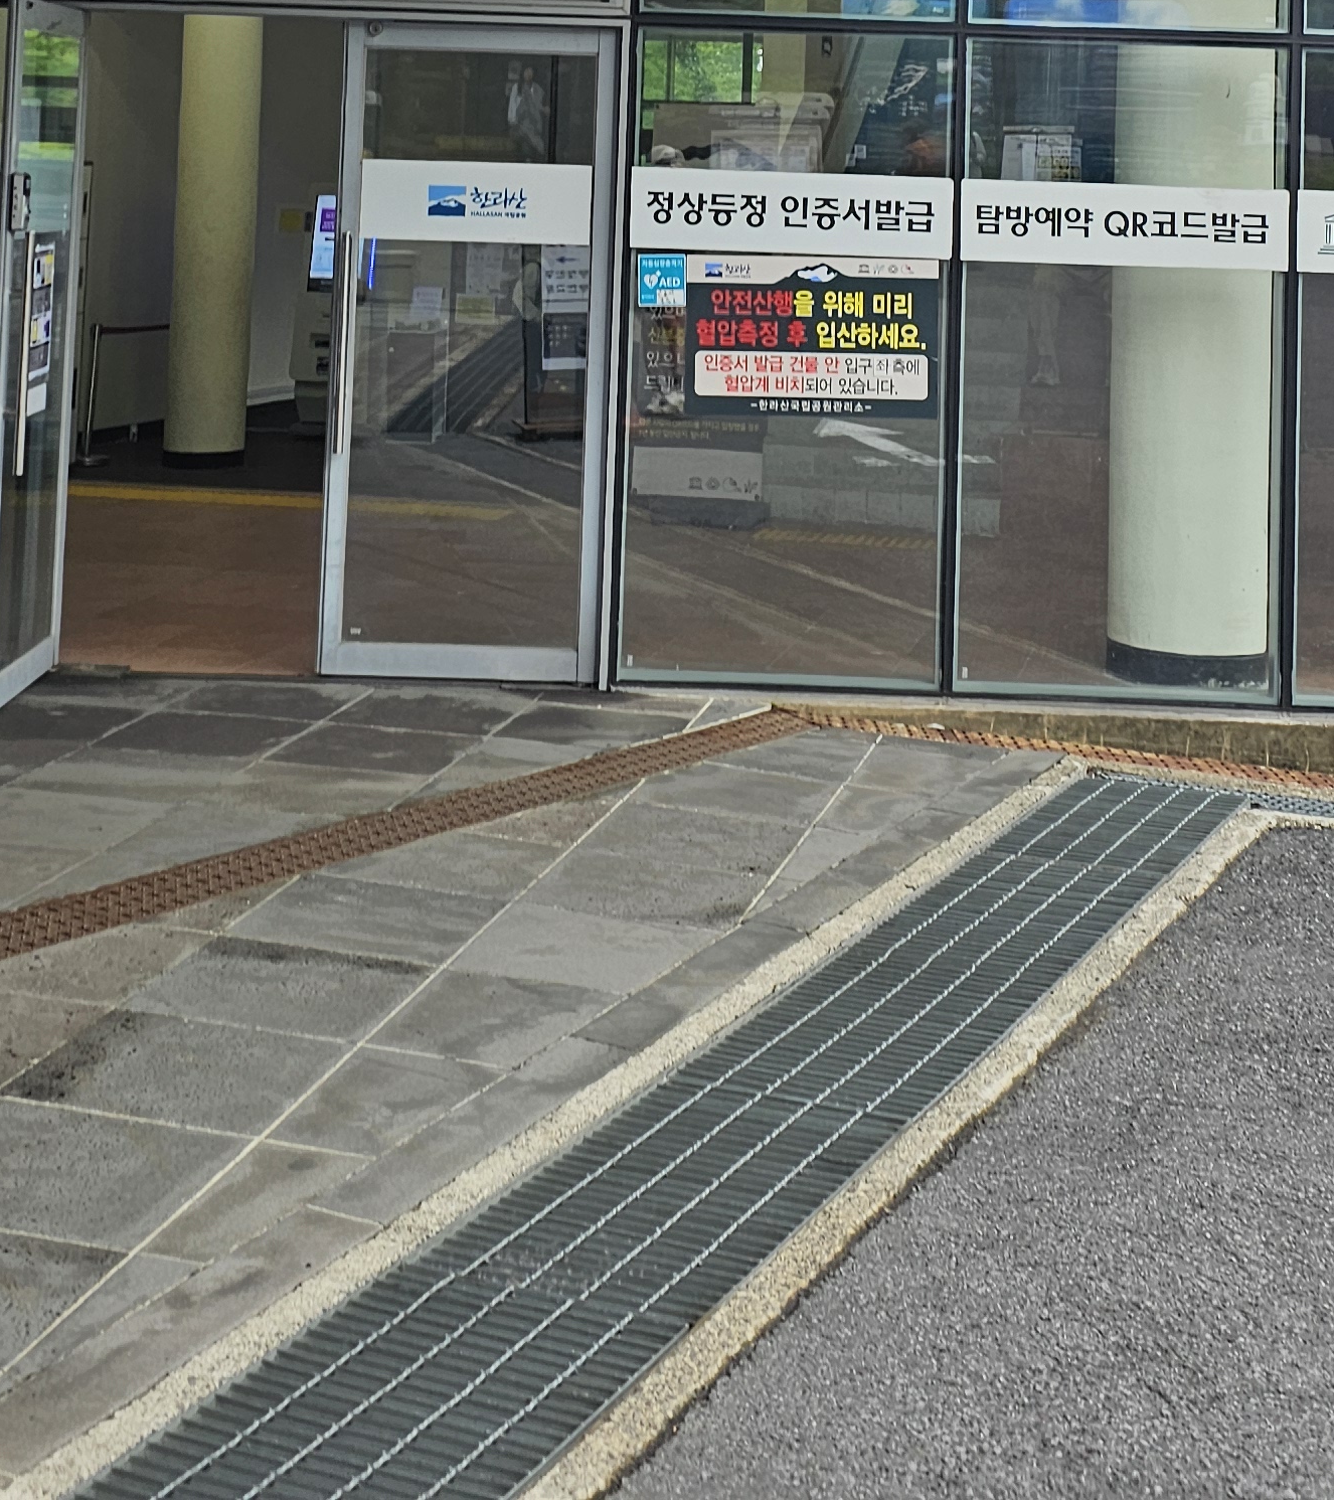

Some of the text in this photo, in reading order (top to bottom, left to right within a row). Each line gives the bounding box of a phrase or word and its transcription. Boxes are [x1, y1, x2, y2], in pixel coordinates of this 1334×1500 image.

[470, 186, 528, 210] 한라산
[646, 189, 936, 233] 정상등정 인증서발급
[975, 203, 1269, 245] 탐방예약 QR코드발급
[659, 276, 681, 288] AED
[711, 289, 913, 320] 안전산행을 위해 미리
[696, 318, 927, 350] 혈압측정 후 입산하세요.
[704, 354, 749, 373] 인증서
[753, 355, 784, 373] 발급
[789, 356, 819, 374] 건물
[824, 357, 840, 374] 안
[844, 358, 872, 375] 입구
[724, 375, 898, 396] 혈압계 비치되어 있습니다.
